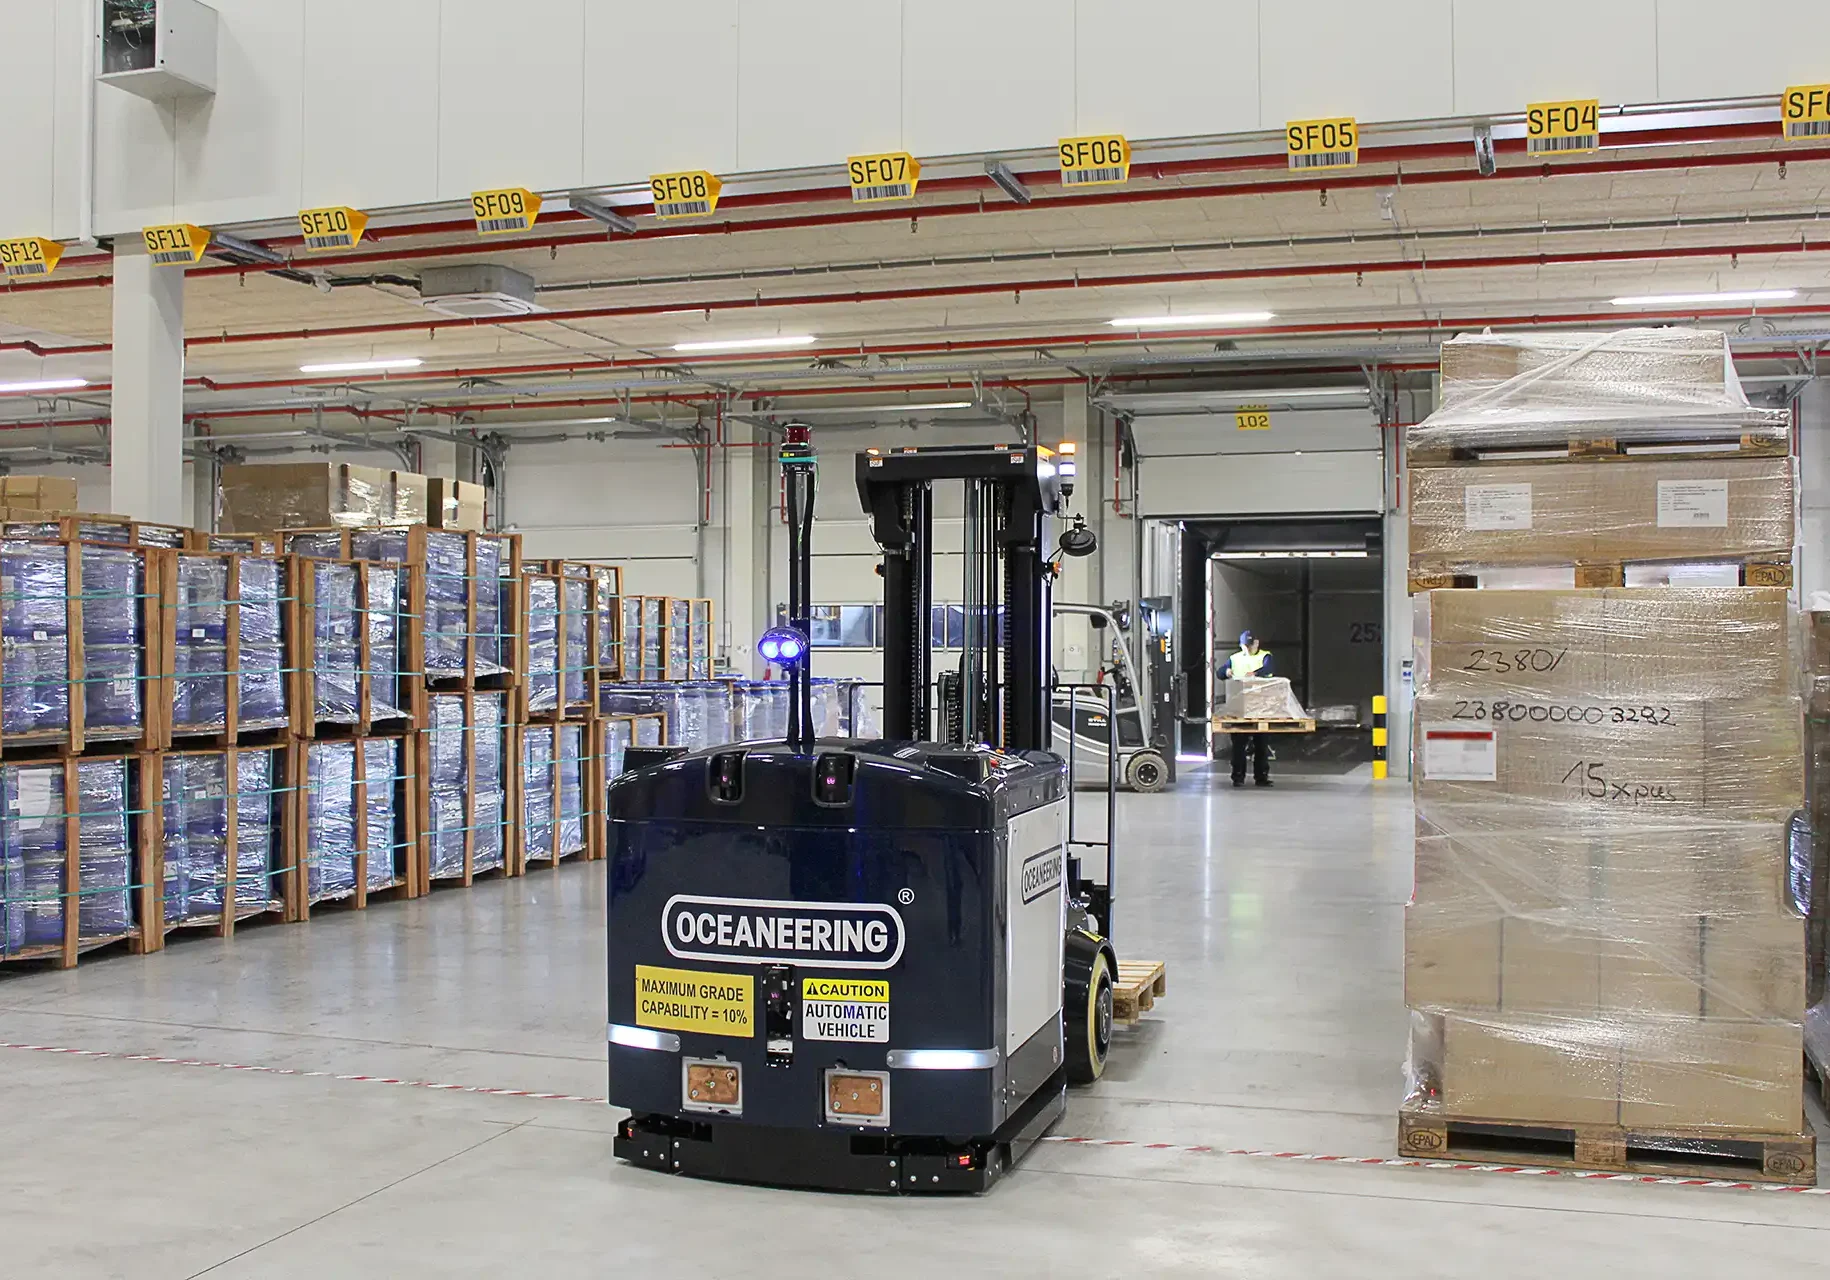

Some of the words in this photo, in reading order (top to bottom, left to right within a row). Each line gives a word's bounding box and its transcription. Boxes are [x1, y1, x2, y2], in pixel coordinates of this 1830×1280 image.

[1788, 90, 1830, 118] SF
[1529, 105, 1596, 135] SF04
[1289, 122, 1353, 151] SF05
[1060, 139, 1122, 167] SF06
[850, 157, 906, 184] SF07
[652, 175, 706, 201] SF08
[473, 192, 524, 217] SF09
[301, 210, 348, 234] SF10
[0, 241, 42, 262] SF12
[145, 228, 190, 250] SF11
[1237, 415, 1269, 428] 102
[675, 911, 889, 953] OCEANEERING
[641, 978, 696, 998] MAXIMUM
[699, 984, 744, 1002] GRADE
[819, 983, 884, 997] CAUTION
[641, 999, 709, 1020] CAPABILITY
[722, 1008, 748, 1024] 10%
[805, 1003, 887, 1020] AUTOMATIC
[817, 1022, 875, 1038] VEHICLE
